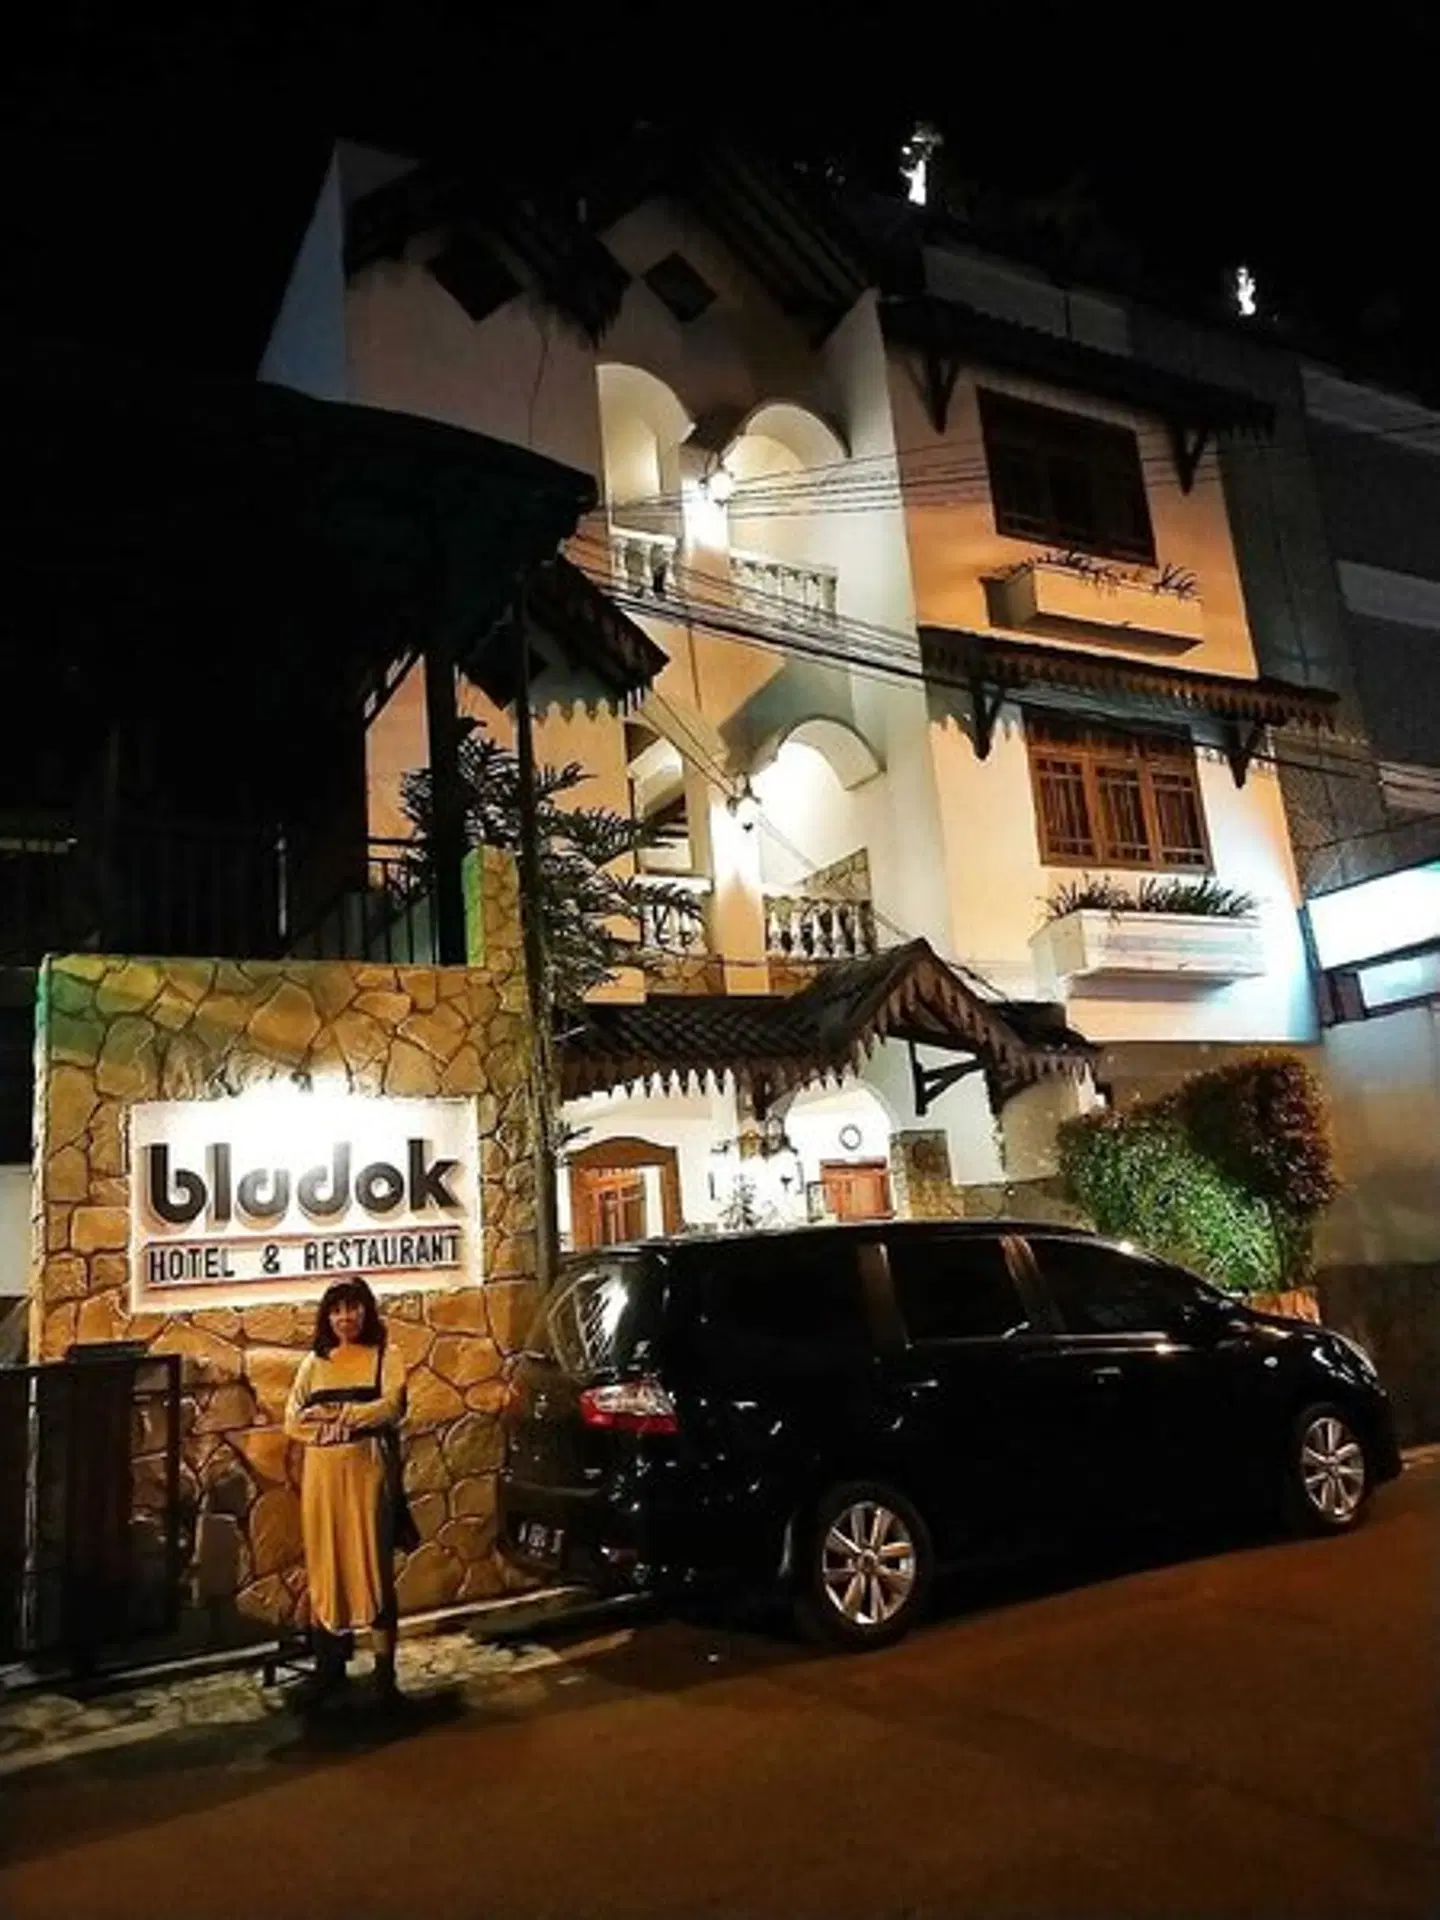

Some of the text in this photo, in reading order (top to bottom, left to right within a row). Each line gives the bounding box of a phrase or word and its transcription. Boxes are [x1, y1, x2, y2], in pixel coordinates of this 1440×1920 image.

[147, 1138, 461, 1225] bladok
[148, 1233, 461, 1283] HOTEL & RESTAURANT
